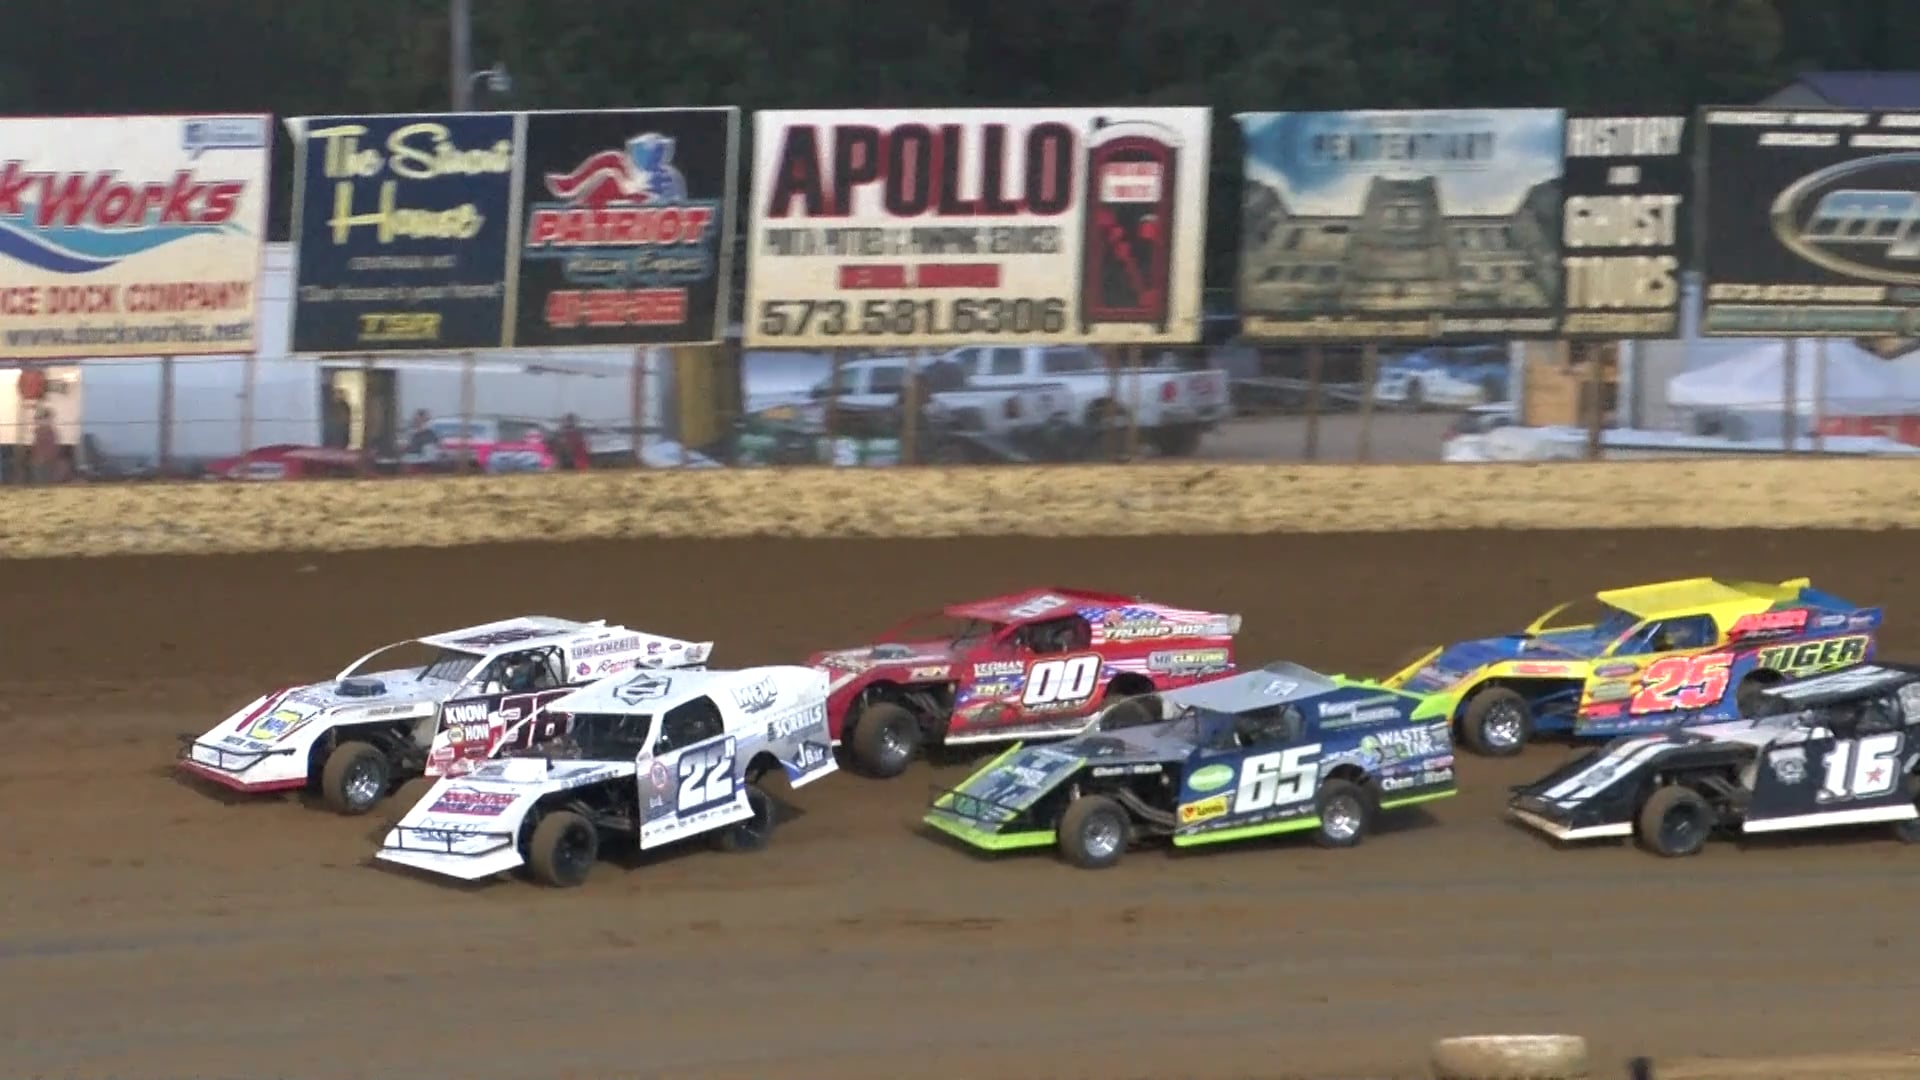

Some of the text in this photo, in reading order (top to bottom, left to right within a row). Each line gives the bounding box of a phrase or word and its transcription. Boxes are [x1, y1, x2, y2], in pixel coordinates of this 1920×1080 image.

[308, 124, 386, 178] The
[1566, 117, 1685, 156] HISTORY
[766, 122, 1078, 218] APOLLO
[526, 207, 715, 247] PATRIOT
[47, 285, 119, 313] DOCK
[126, 281, 252, 312] COMPANY
[759, 299, 1067, 336] 573.581.6306
[1105, 625, 1169, 639] TRUMP
[1757, 636, 1869, 673] TIGER
[1022, 656, 1100, 705] 00
[1630, 653, 1735, 714] 25
[445, 704, 488, 724] KNOW
[465, 723, 489, 741] HOW
[1376, 725, 1430, 748] WASTE
[678, 746, 733, 812] 22
[1234, 743, 1322, 813] 65
[1821, 735, 1902, 799] 16
